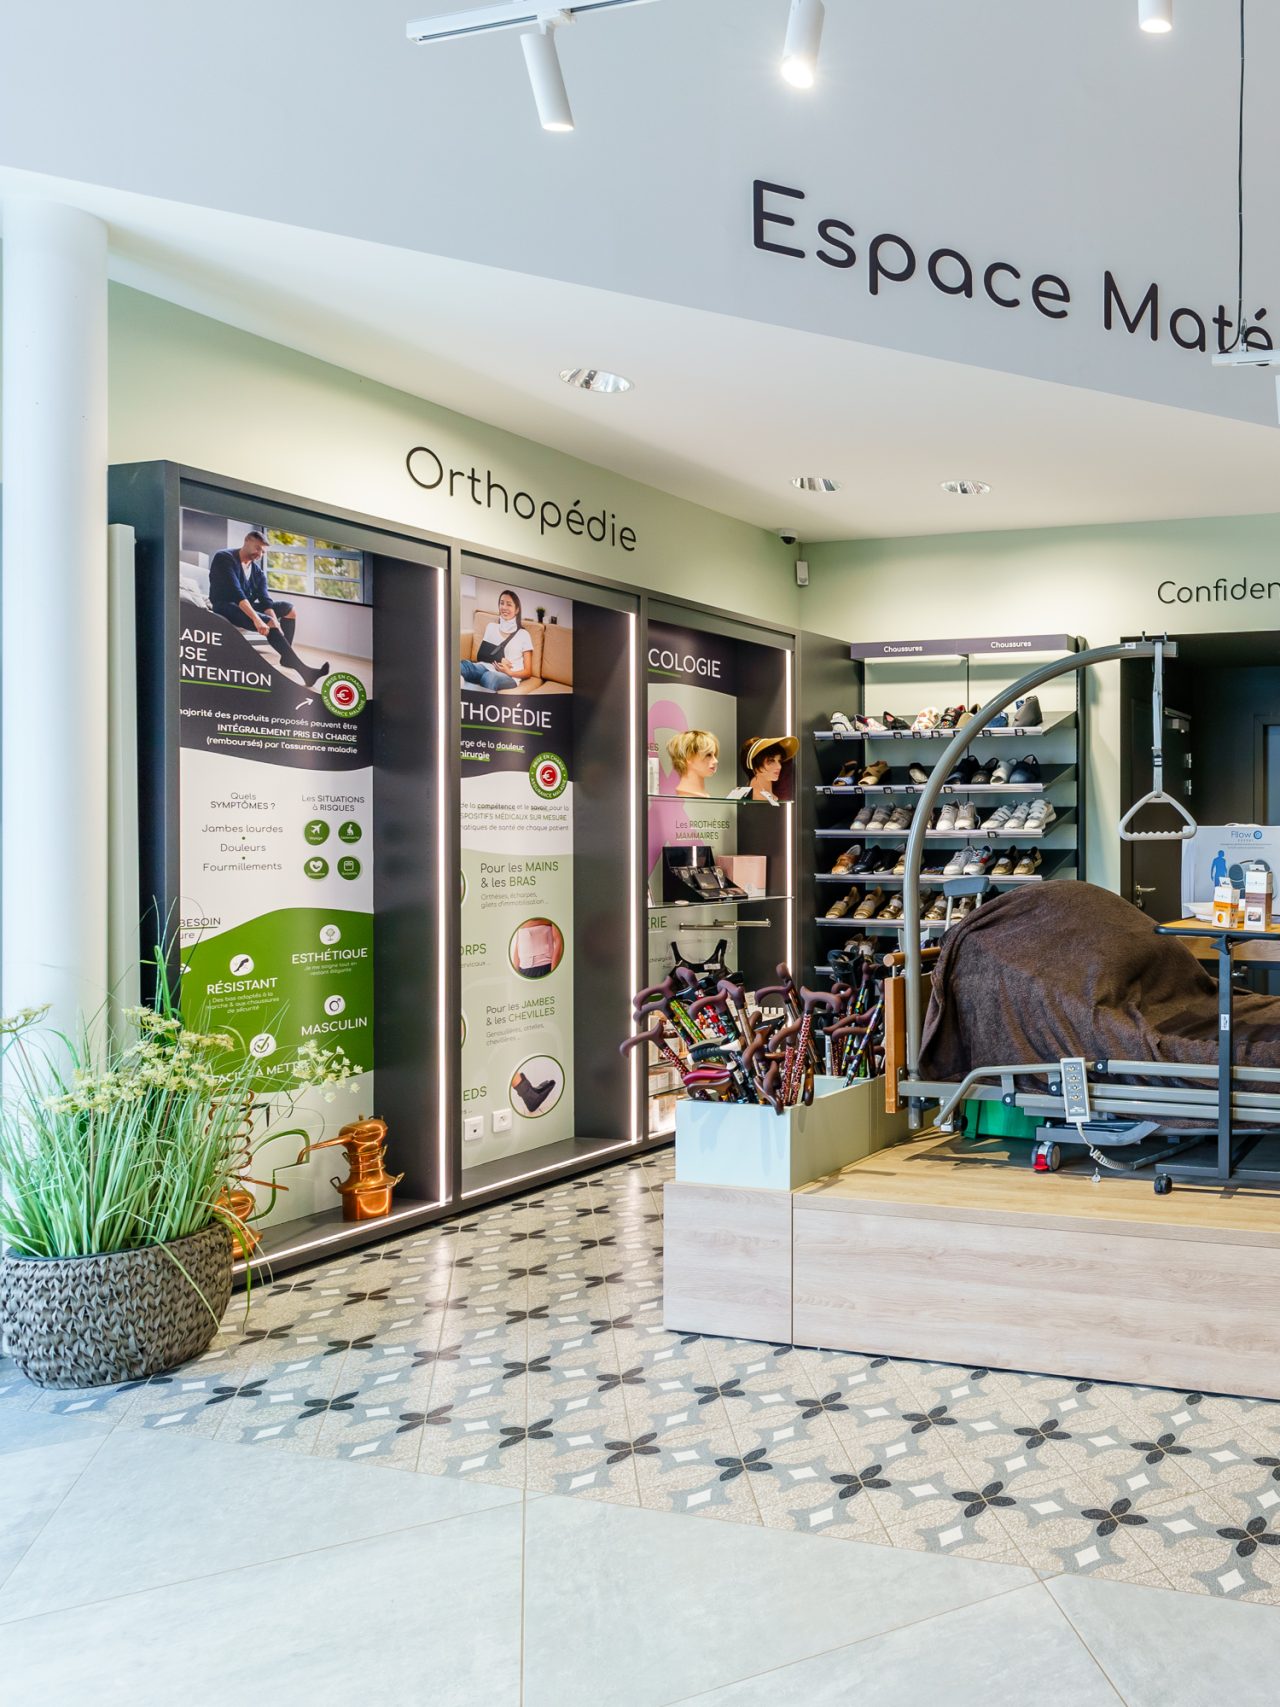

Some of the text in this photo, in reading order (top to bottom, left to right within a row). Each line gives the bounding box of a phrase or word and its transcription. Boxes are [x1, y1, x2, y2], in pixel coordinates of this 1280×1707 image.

[753, 179, 1070, 319] Espace
[406, 446, 636, 551] Orthopédie
[181, 663, 271, 687] NTENTION
[214, 711, 231, 719] des
[233, 712, 269, 723] produits
[271, 715, 309, 726] proposés
[311, 721, 341, 730] peuvent
[342, 722, 358, 730] être
[217, 723, 358, 742] INTÉGRALEMENT PRIS EN CHARGE
[206, 736, 263, 748] (remboursés)
[264, 741, 279, 749] par
[328, 746, 358, 754] maladie
[476, 740, 486, 748] de
[496, 742, 525, 751] douleur
[230, 792, 256, 800] Quels
[317, 795, 365, 803] SITUATIONS
[210, 801, 268, 810] SYMPTÔMES
[319, 804, 355, 812] RISQUES
[202, 825, 283, 833] Jambes lourdes
[675, 819, 730, 829] Les PROTHÈSES
[675, 832, 719, 840] MAMMAIRES
[220, 844, 266, 852] Douleurs
[203, 862, 282, 872] Fourmillements
[480, 861, 559, 873] Pour les MAINS
[480, 875, 536, 888] & les BRAS
[291, 948, 368, 964] ESTHÉTIQUE
[207, 977, 278, 995] RÉSISTANT
[486, 996, 555, 1014] Pour les JAMBES
[486, 1007, 555, 1026] & les CHEVILLES
[301, 1017, 368, 1037] MASCULIN
